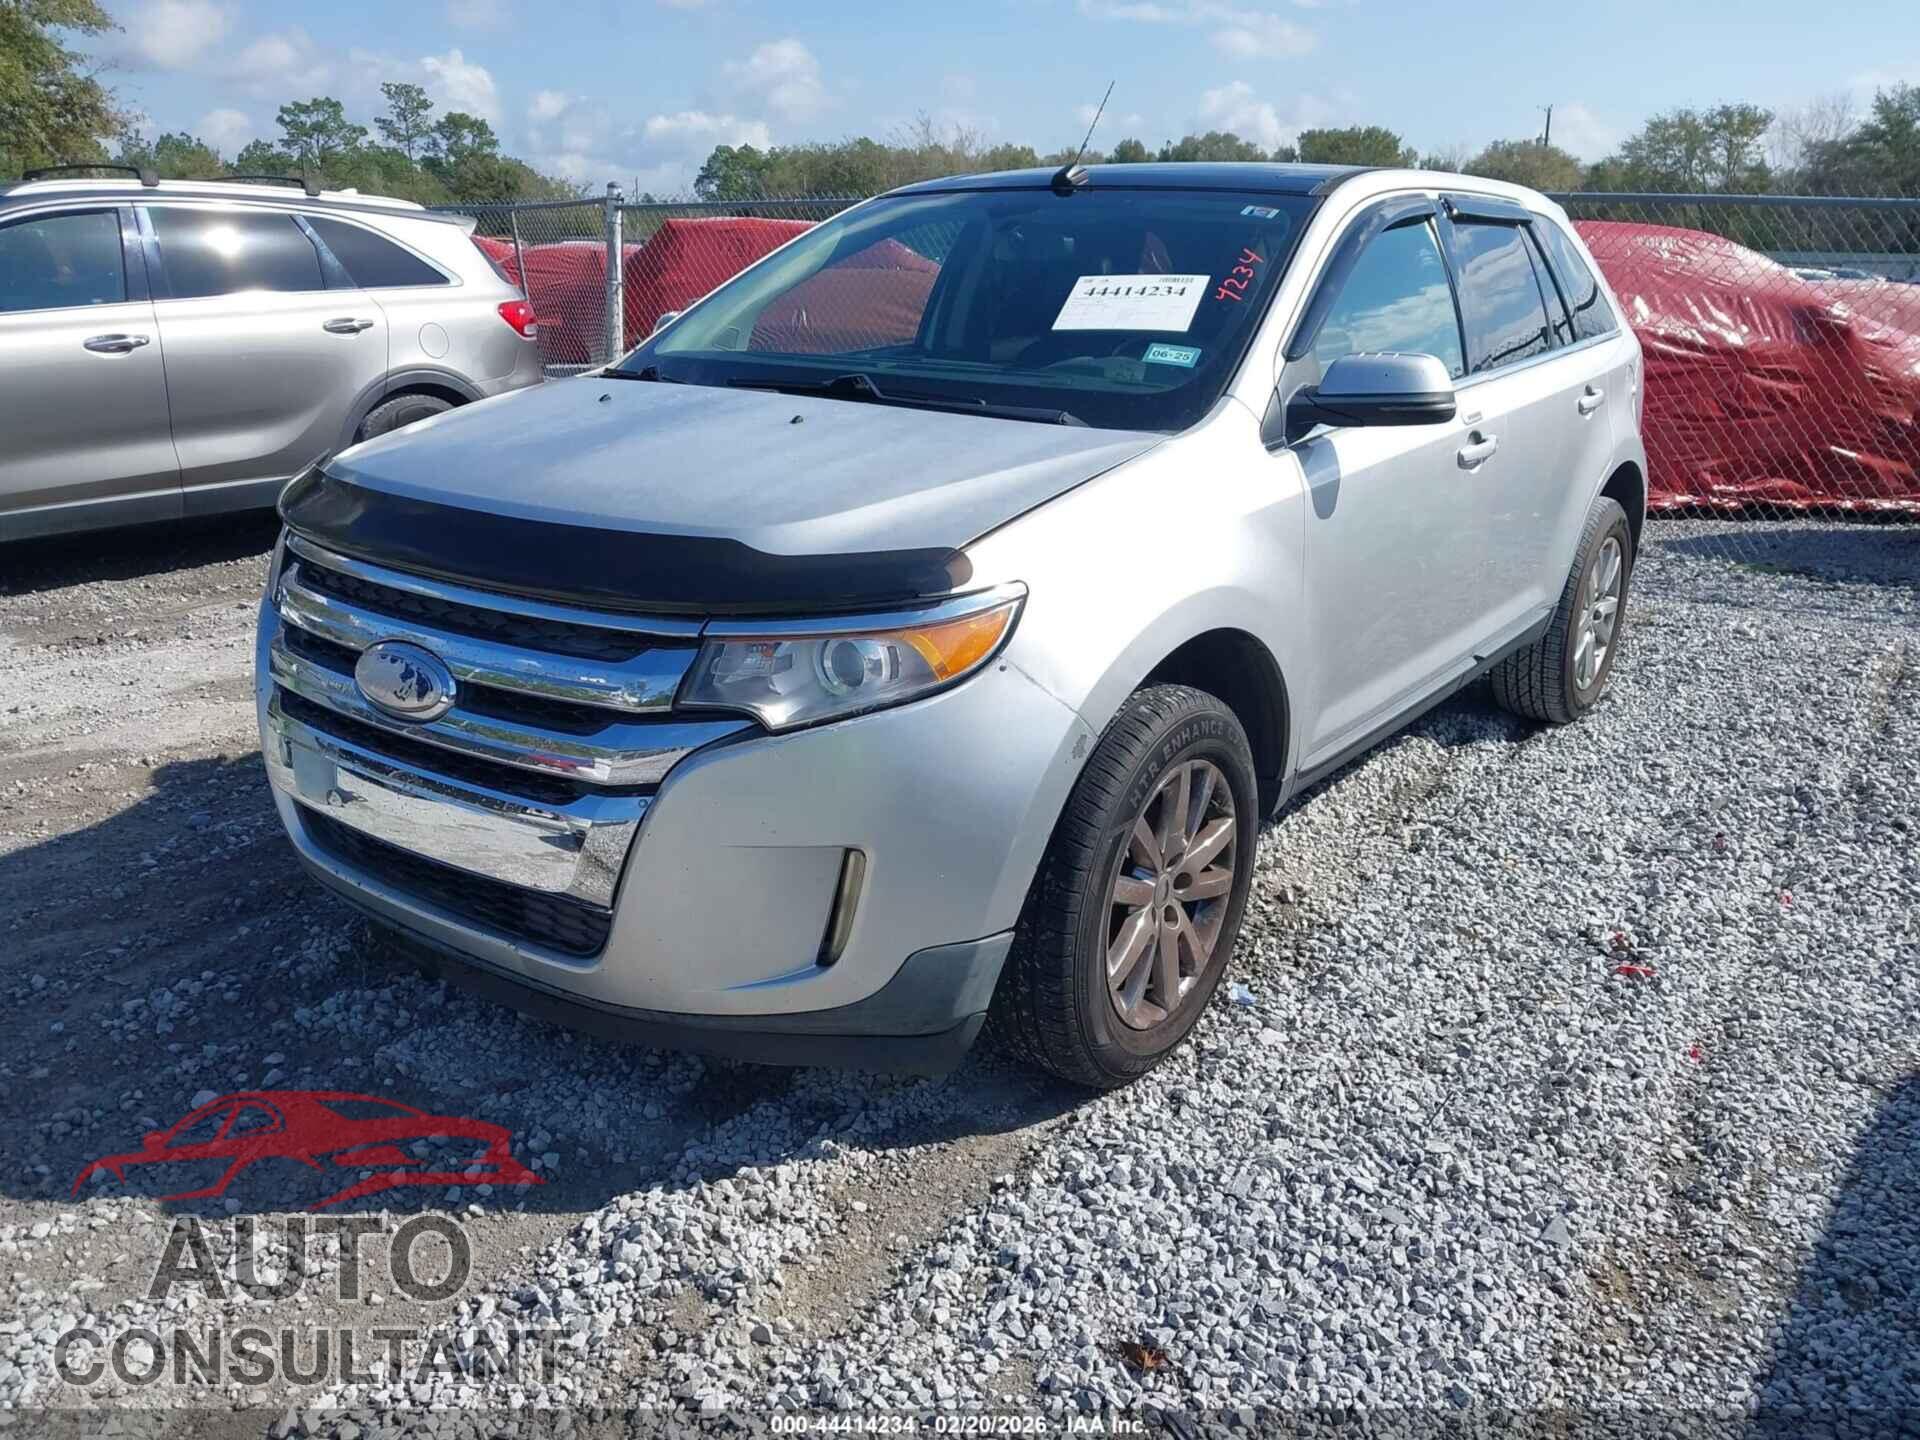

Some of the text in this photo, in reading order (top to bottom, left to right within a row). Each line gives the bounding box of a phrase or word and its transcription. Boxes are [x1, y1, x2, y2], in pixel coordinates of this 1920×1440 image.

[1085, 286, 1187, 297] 44414234
[1216, 248, 1264, 301] 4234
[1163, 720, 1224, 759] ENHANCE
